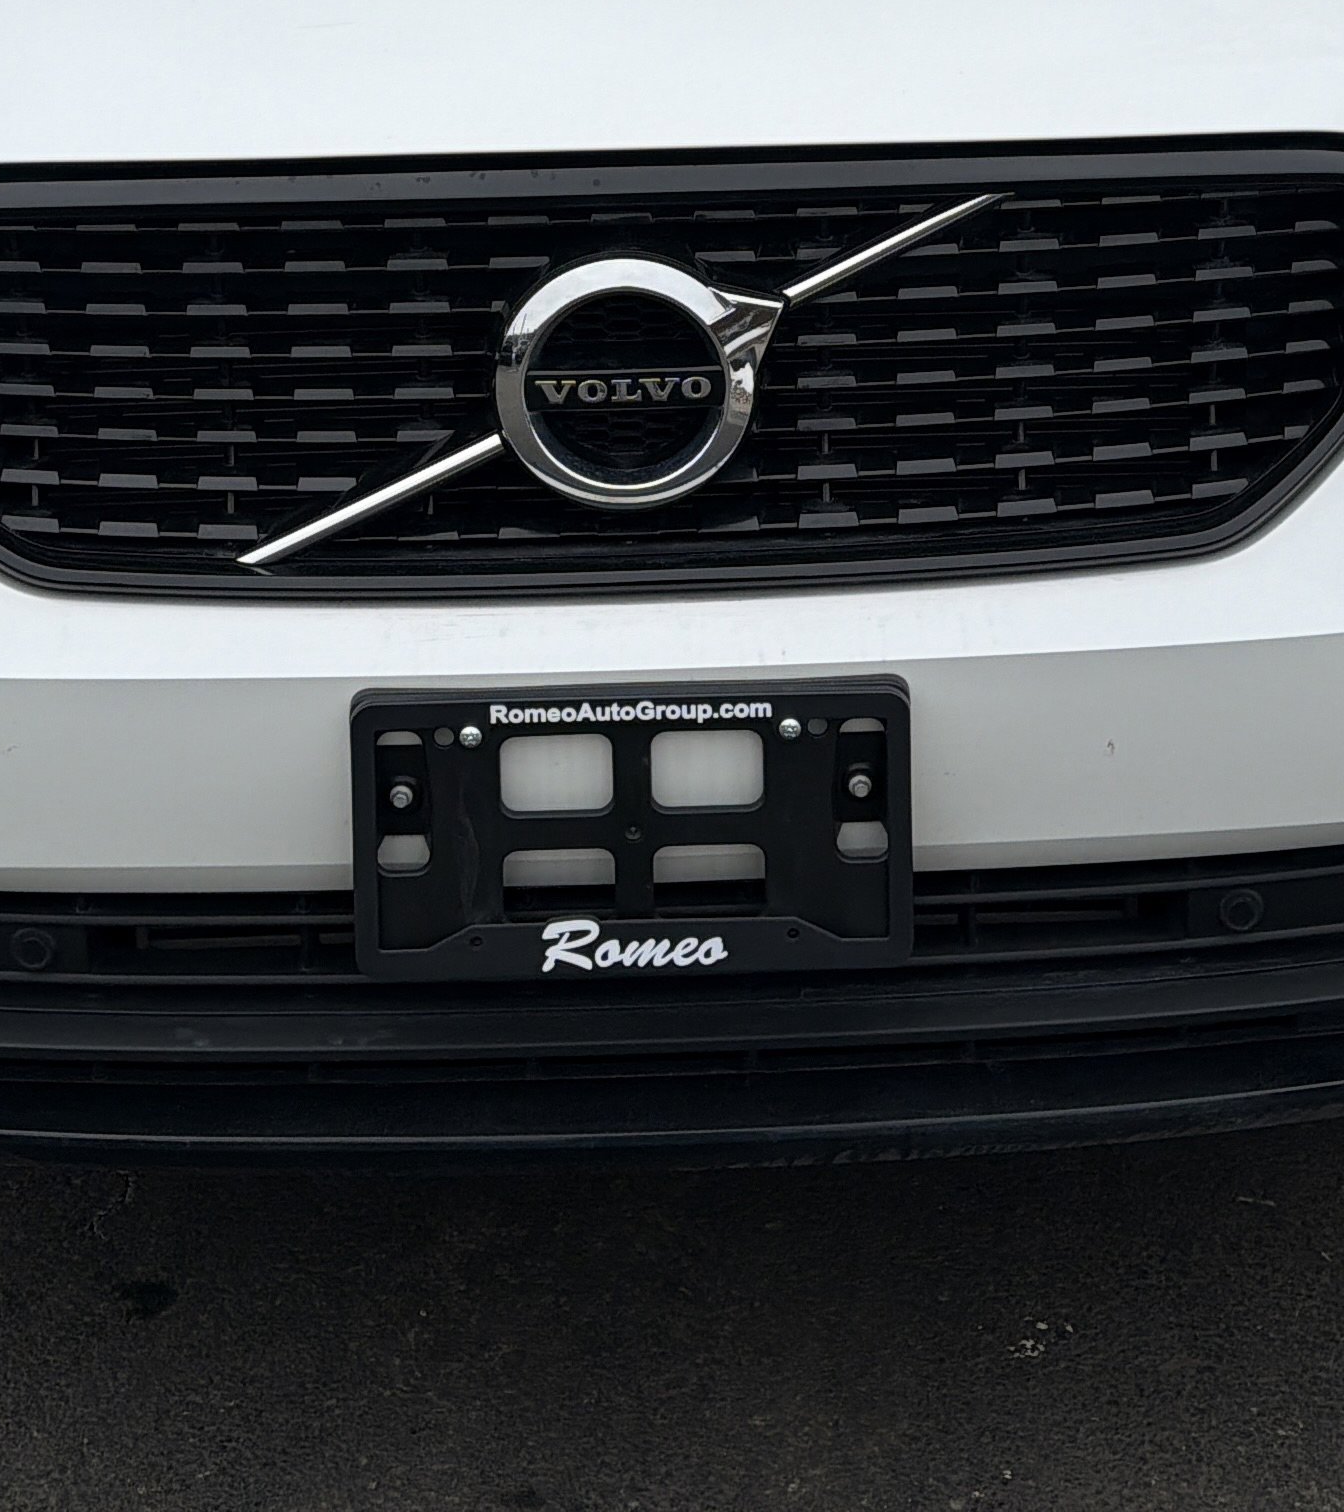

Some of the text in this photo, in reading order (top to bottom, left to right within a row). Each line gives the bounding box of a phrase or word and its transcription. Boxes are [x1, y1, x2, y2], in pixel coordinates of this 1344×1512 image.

[534, 375, 712, 405] VOLVO
[489, 701, 773, 724] RomeoAutoGroup.com
[541, 919, 729, 973] Romeo
